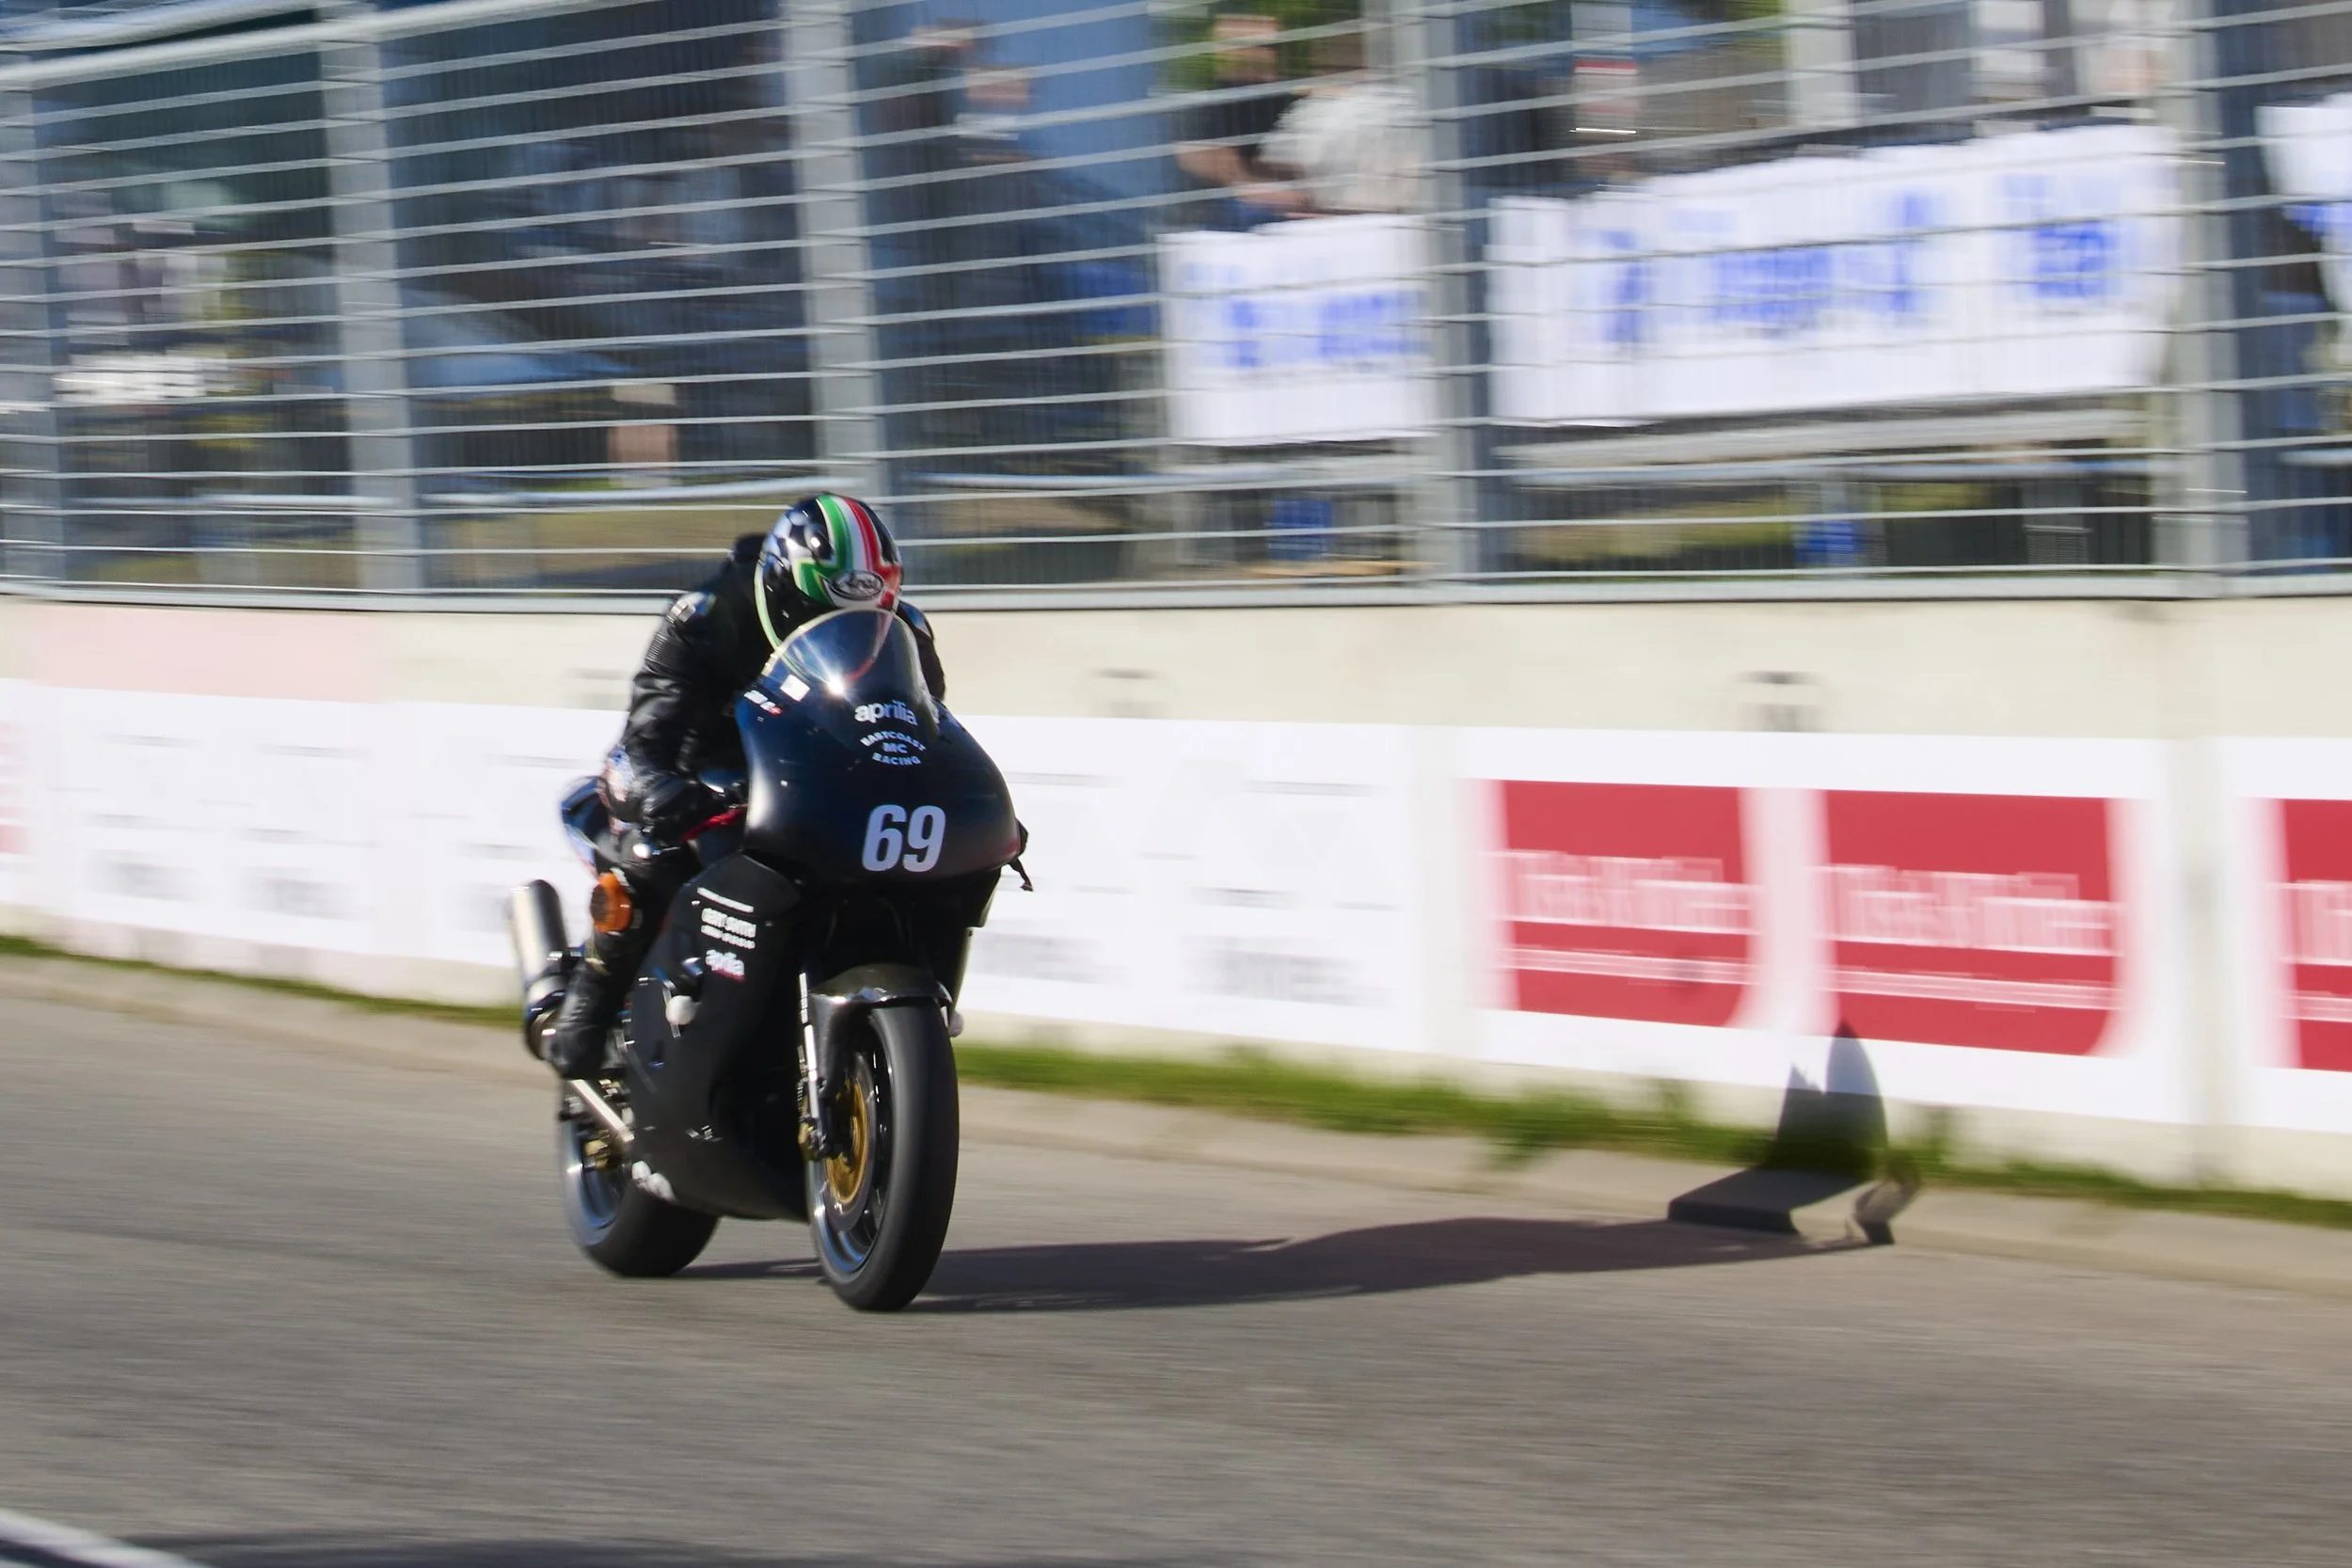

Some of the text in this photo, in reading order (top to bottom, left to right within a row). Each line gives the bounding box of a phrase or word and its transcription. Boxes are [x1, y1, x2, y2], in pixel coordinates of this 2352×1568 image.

[854, 700, 918, 726] aprilia
[872, 752, 922, 766] RACING
[862, 804, 946, 873] 69
